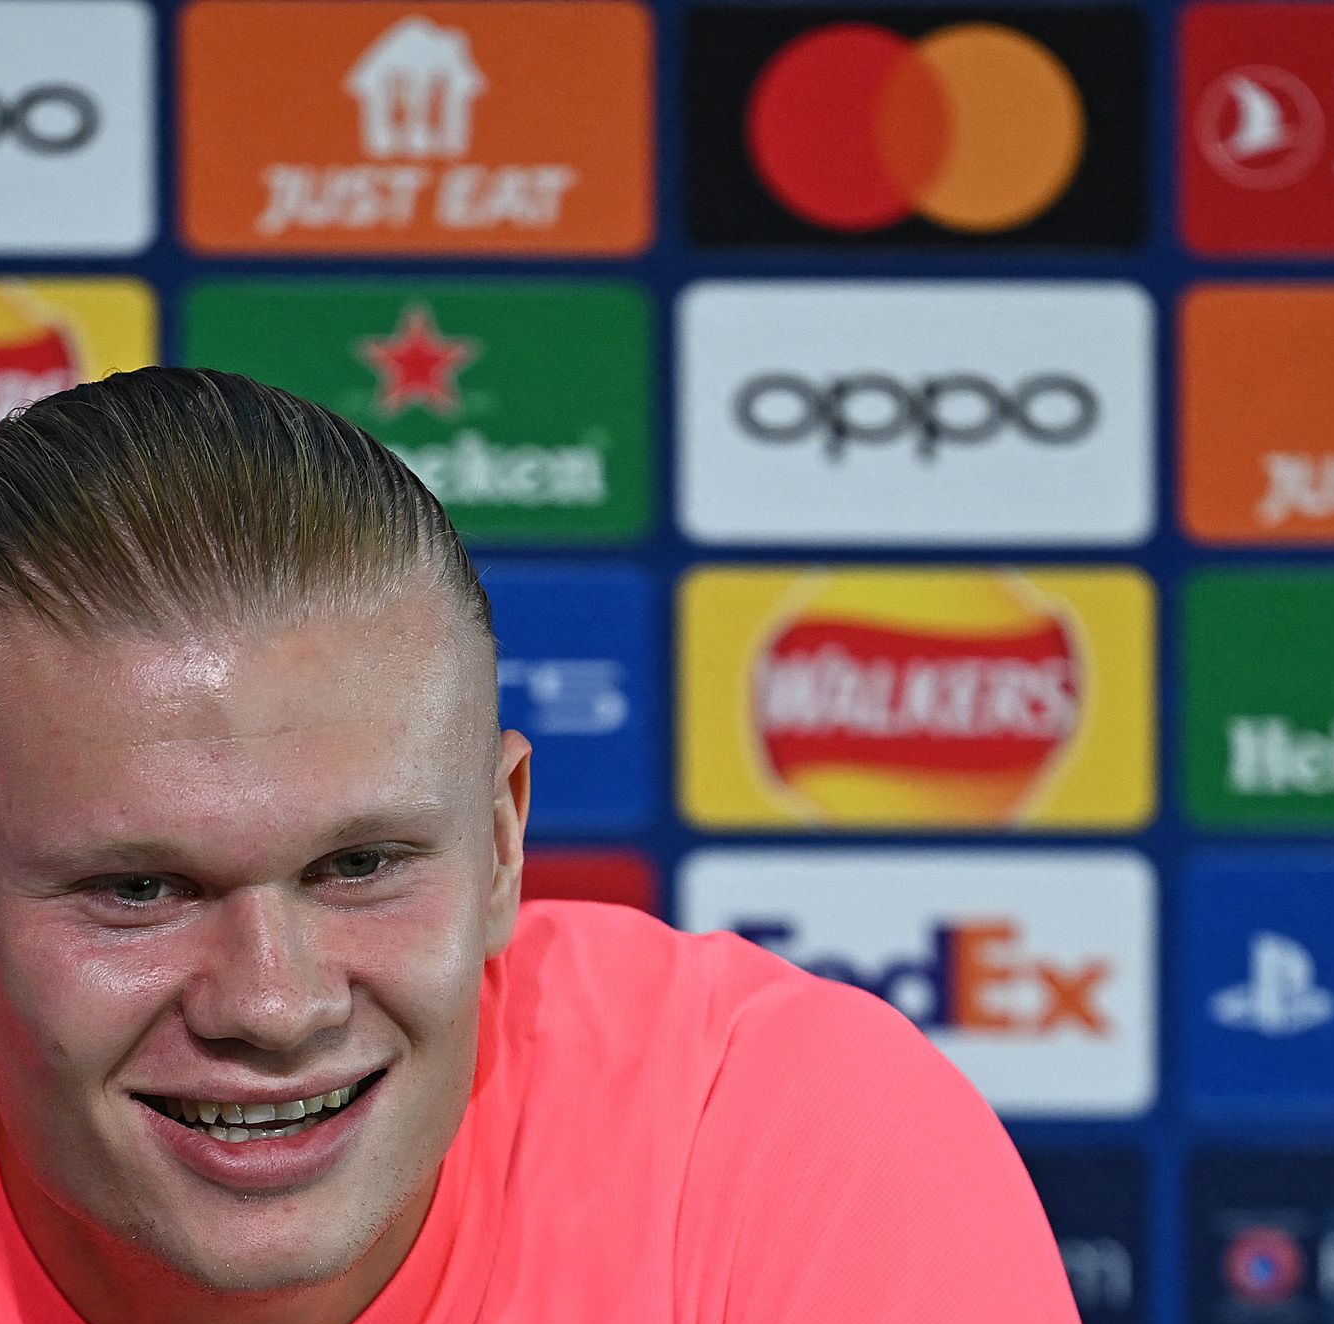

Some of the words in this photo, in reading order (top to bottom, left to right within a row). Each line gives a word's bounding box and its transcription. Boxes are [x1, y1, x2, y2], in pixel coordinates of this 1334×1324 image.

[255, 162, 427, 235] JUST
[435, 162, 576, 229] EAT
[733, 374, 1100, 463] oppo
[757, 643, 1079, 738] WALKERS
